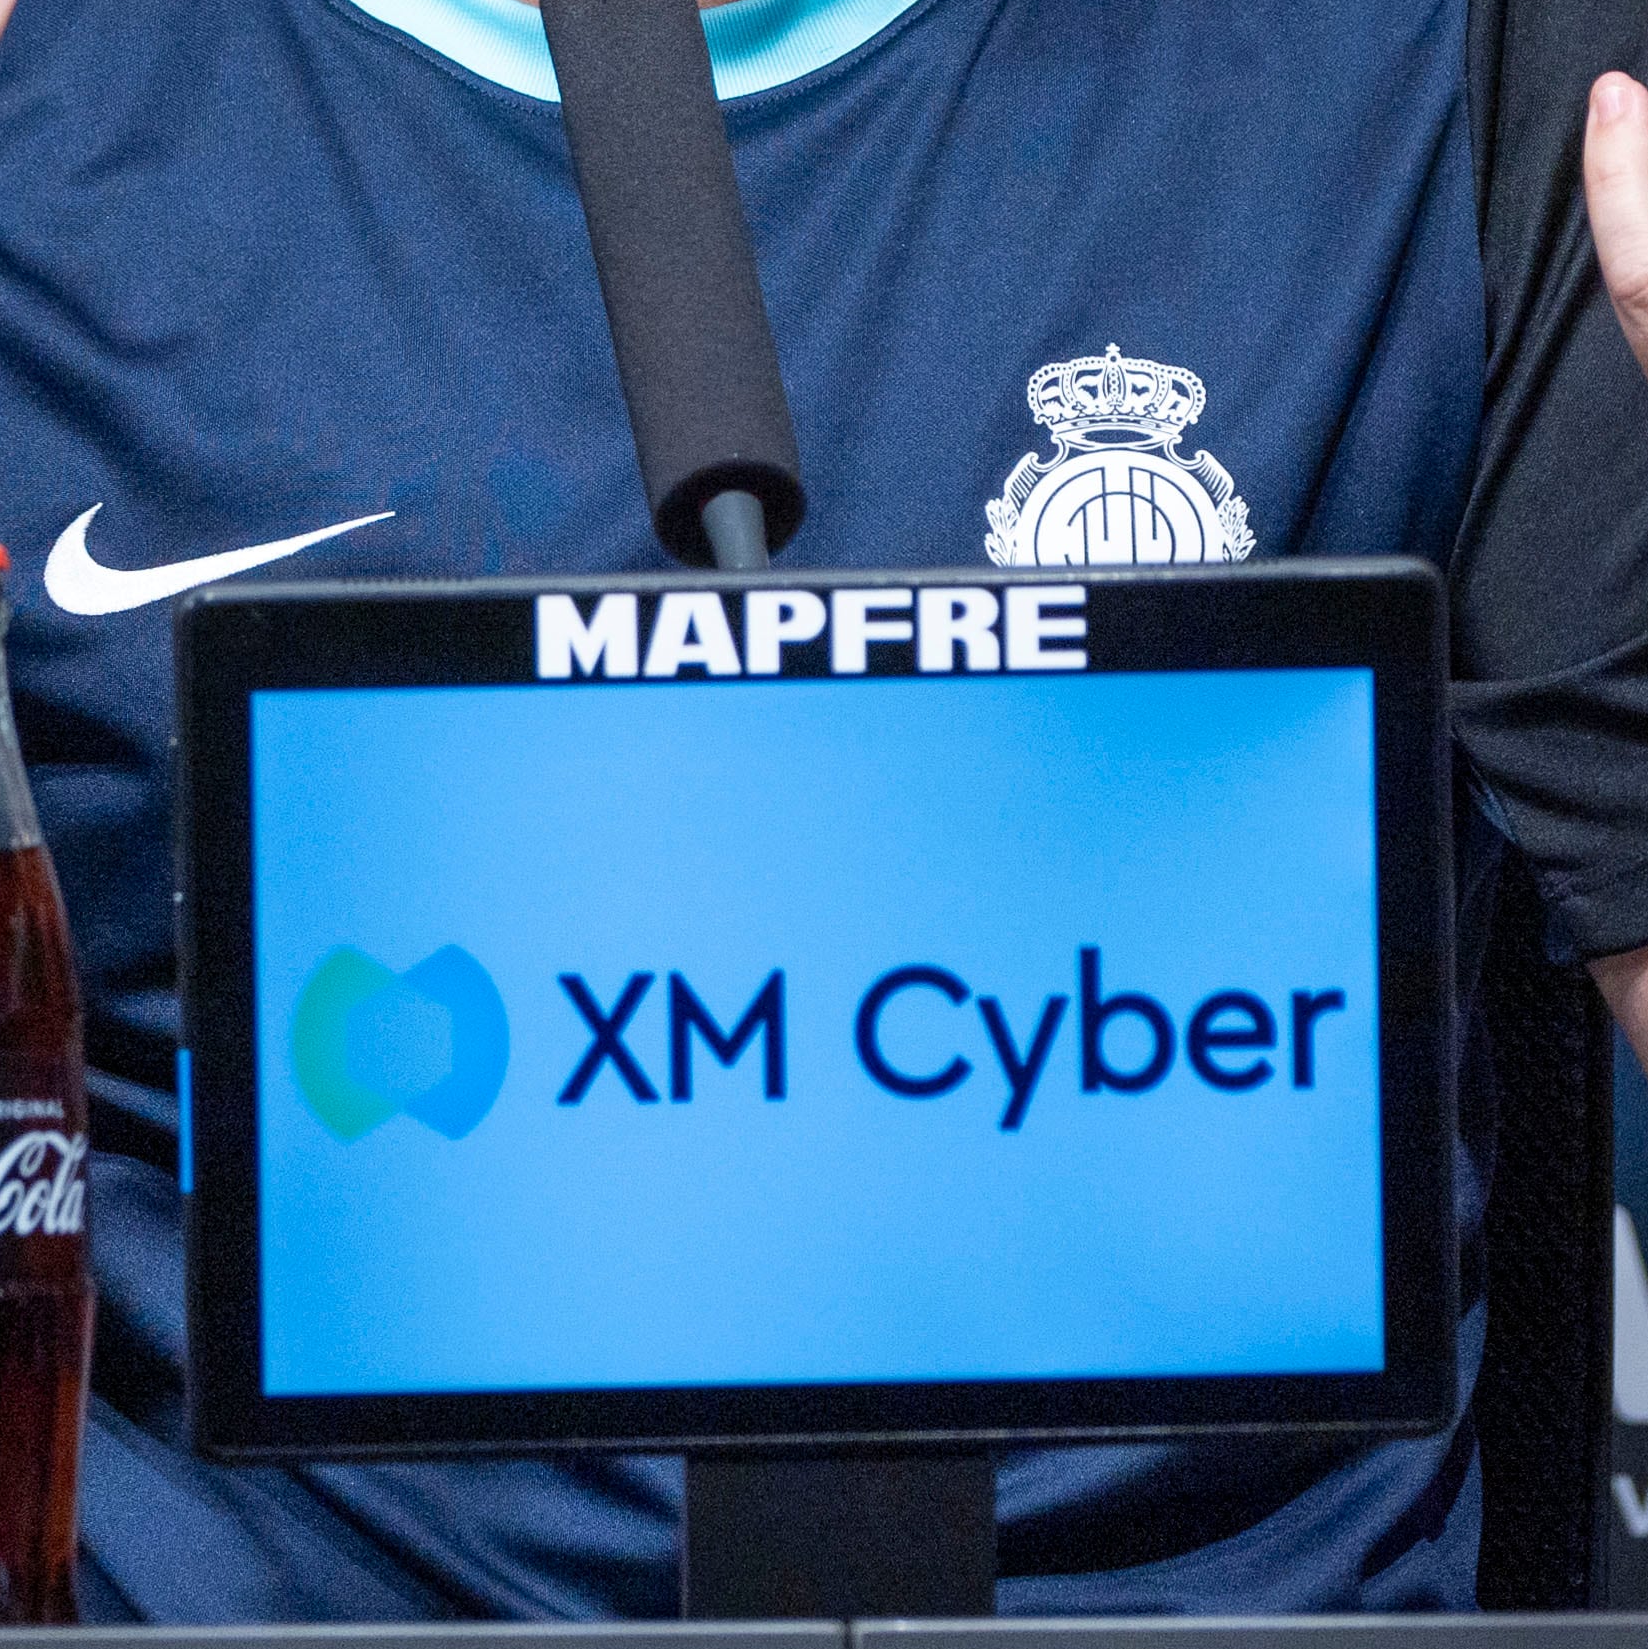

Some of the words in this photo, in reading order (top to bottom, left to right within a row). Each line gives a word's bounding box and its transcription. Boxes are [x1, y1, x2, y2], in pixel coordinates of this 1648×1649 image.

[535, 586, 1088, 679] MAPFRE
[555, 968, 788, 1107] XM
[853, 944, 1347, 1133] Cyber
